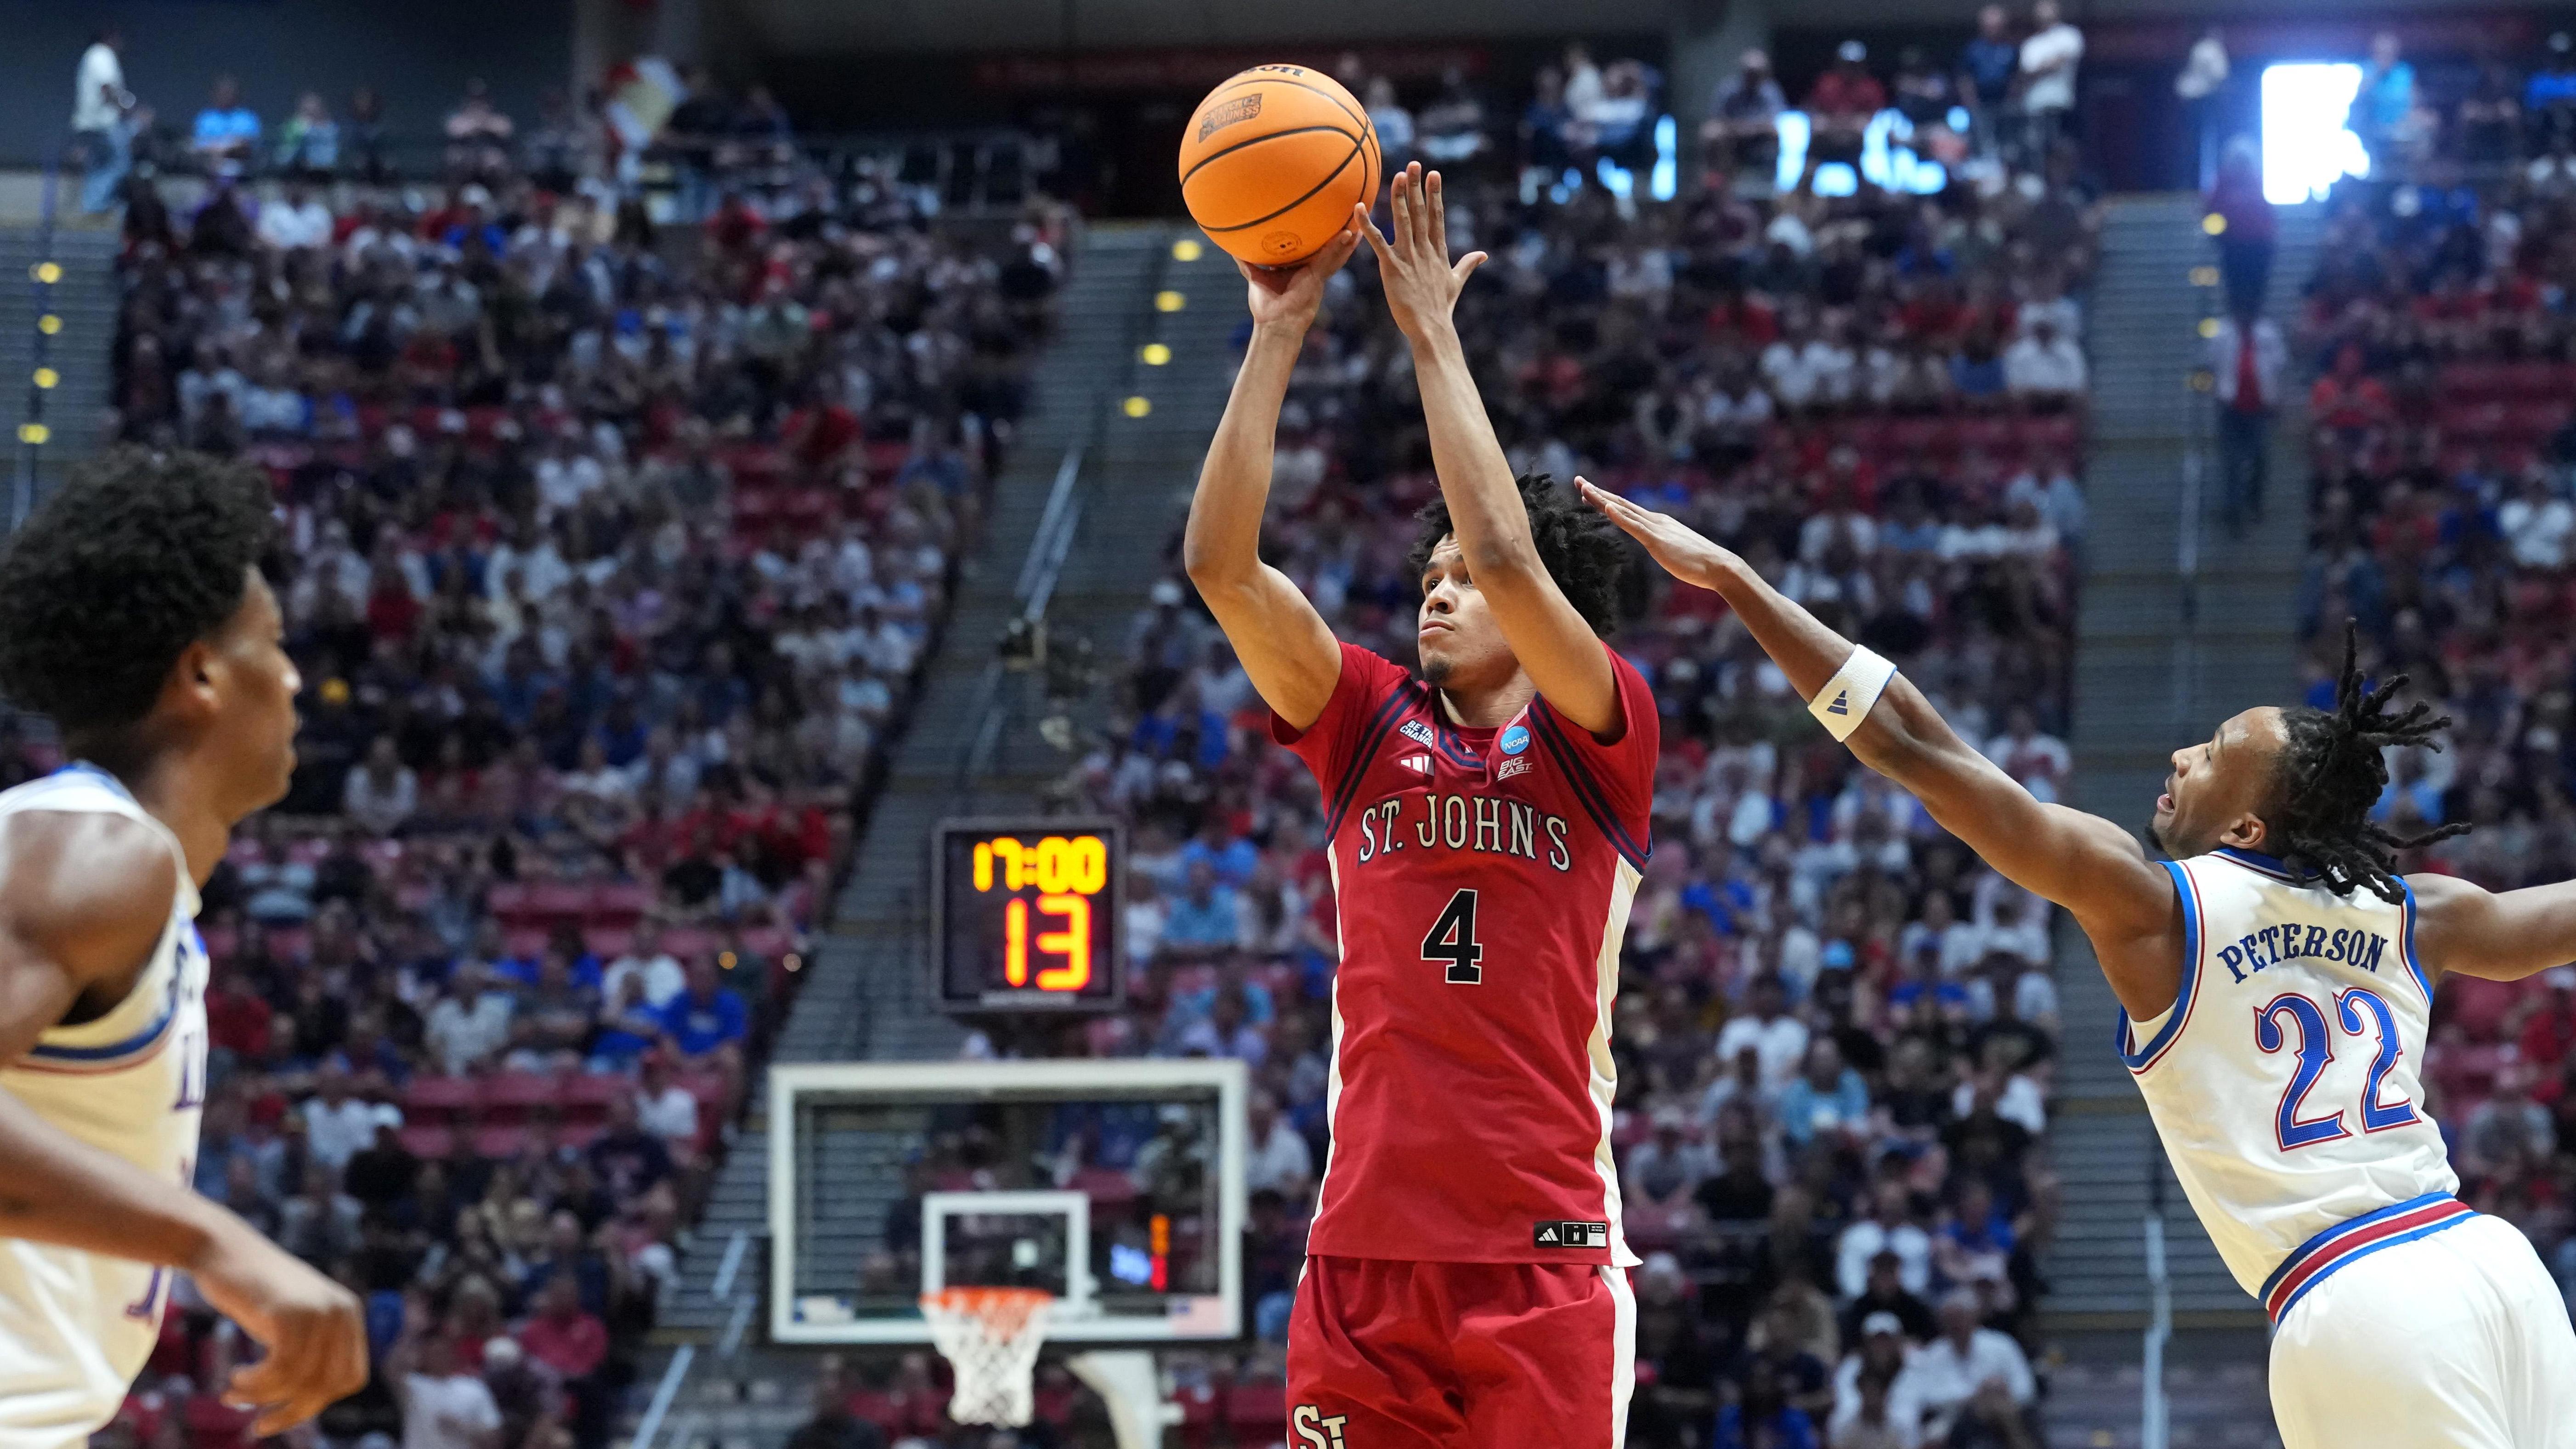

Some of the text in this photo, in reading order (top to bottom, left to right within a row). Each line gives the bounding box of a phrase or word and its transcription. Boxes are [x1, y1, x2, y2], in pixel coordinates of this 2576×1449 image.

[1407, 720, 1422, 732] BE
[1504, 736, 1529, 750] NCAA
[1497, 763, 1533, 779] EAST
[1500, 756, 1524, 771] BIG
[1358, 794, 1571, 871] ST. JOHN'S
[973, 835, 1107, 895] 17:00
[1005, 893, 1092, 991] 13
[1421, 887, 1483, 985] 4
[2216, 923, 2389, 985] PETERSON
[2253, 986, 2423, 1153] 22
[1573, 1232, 1580, 1241] M
